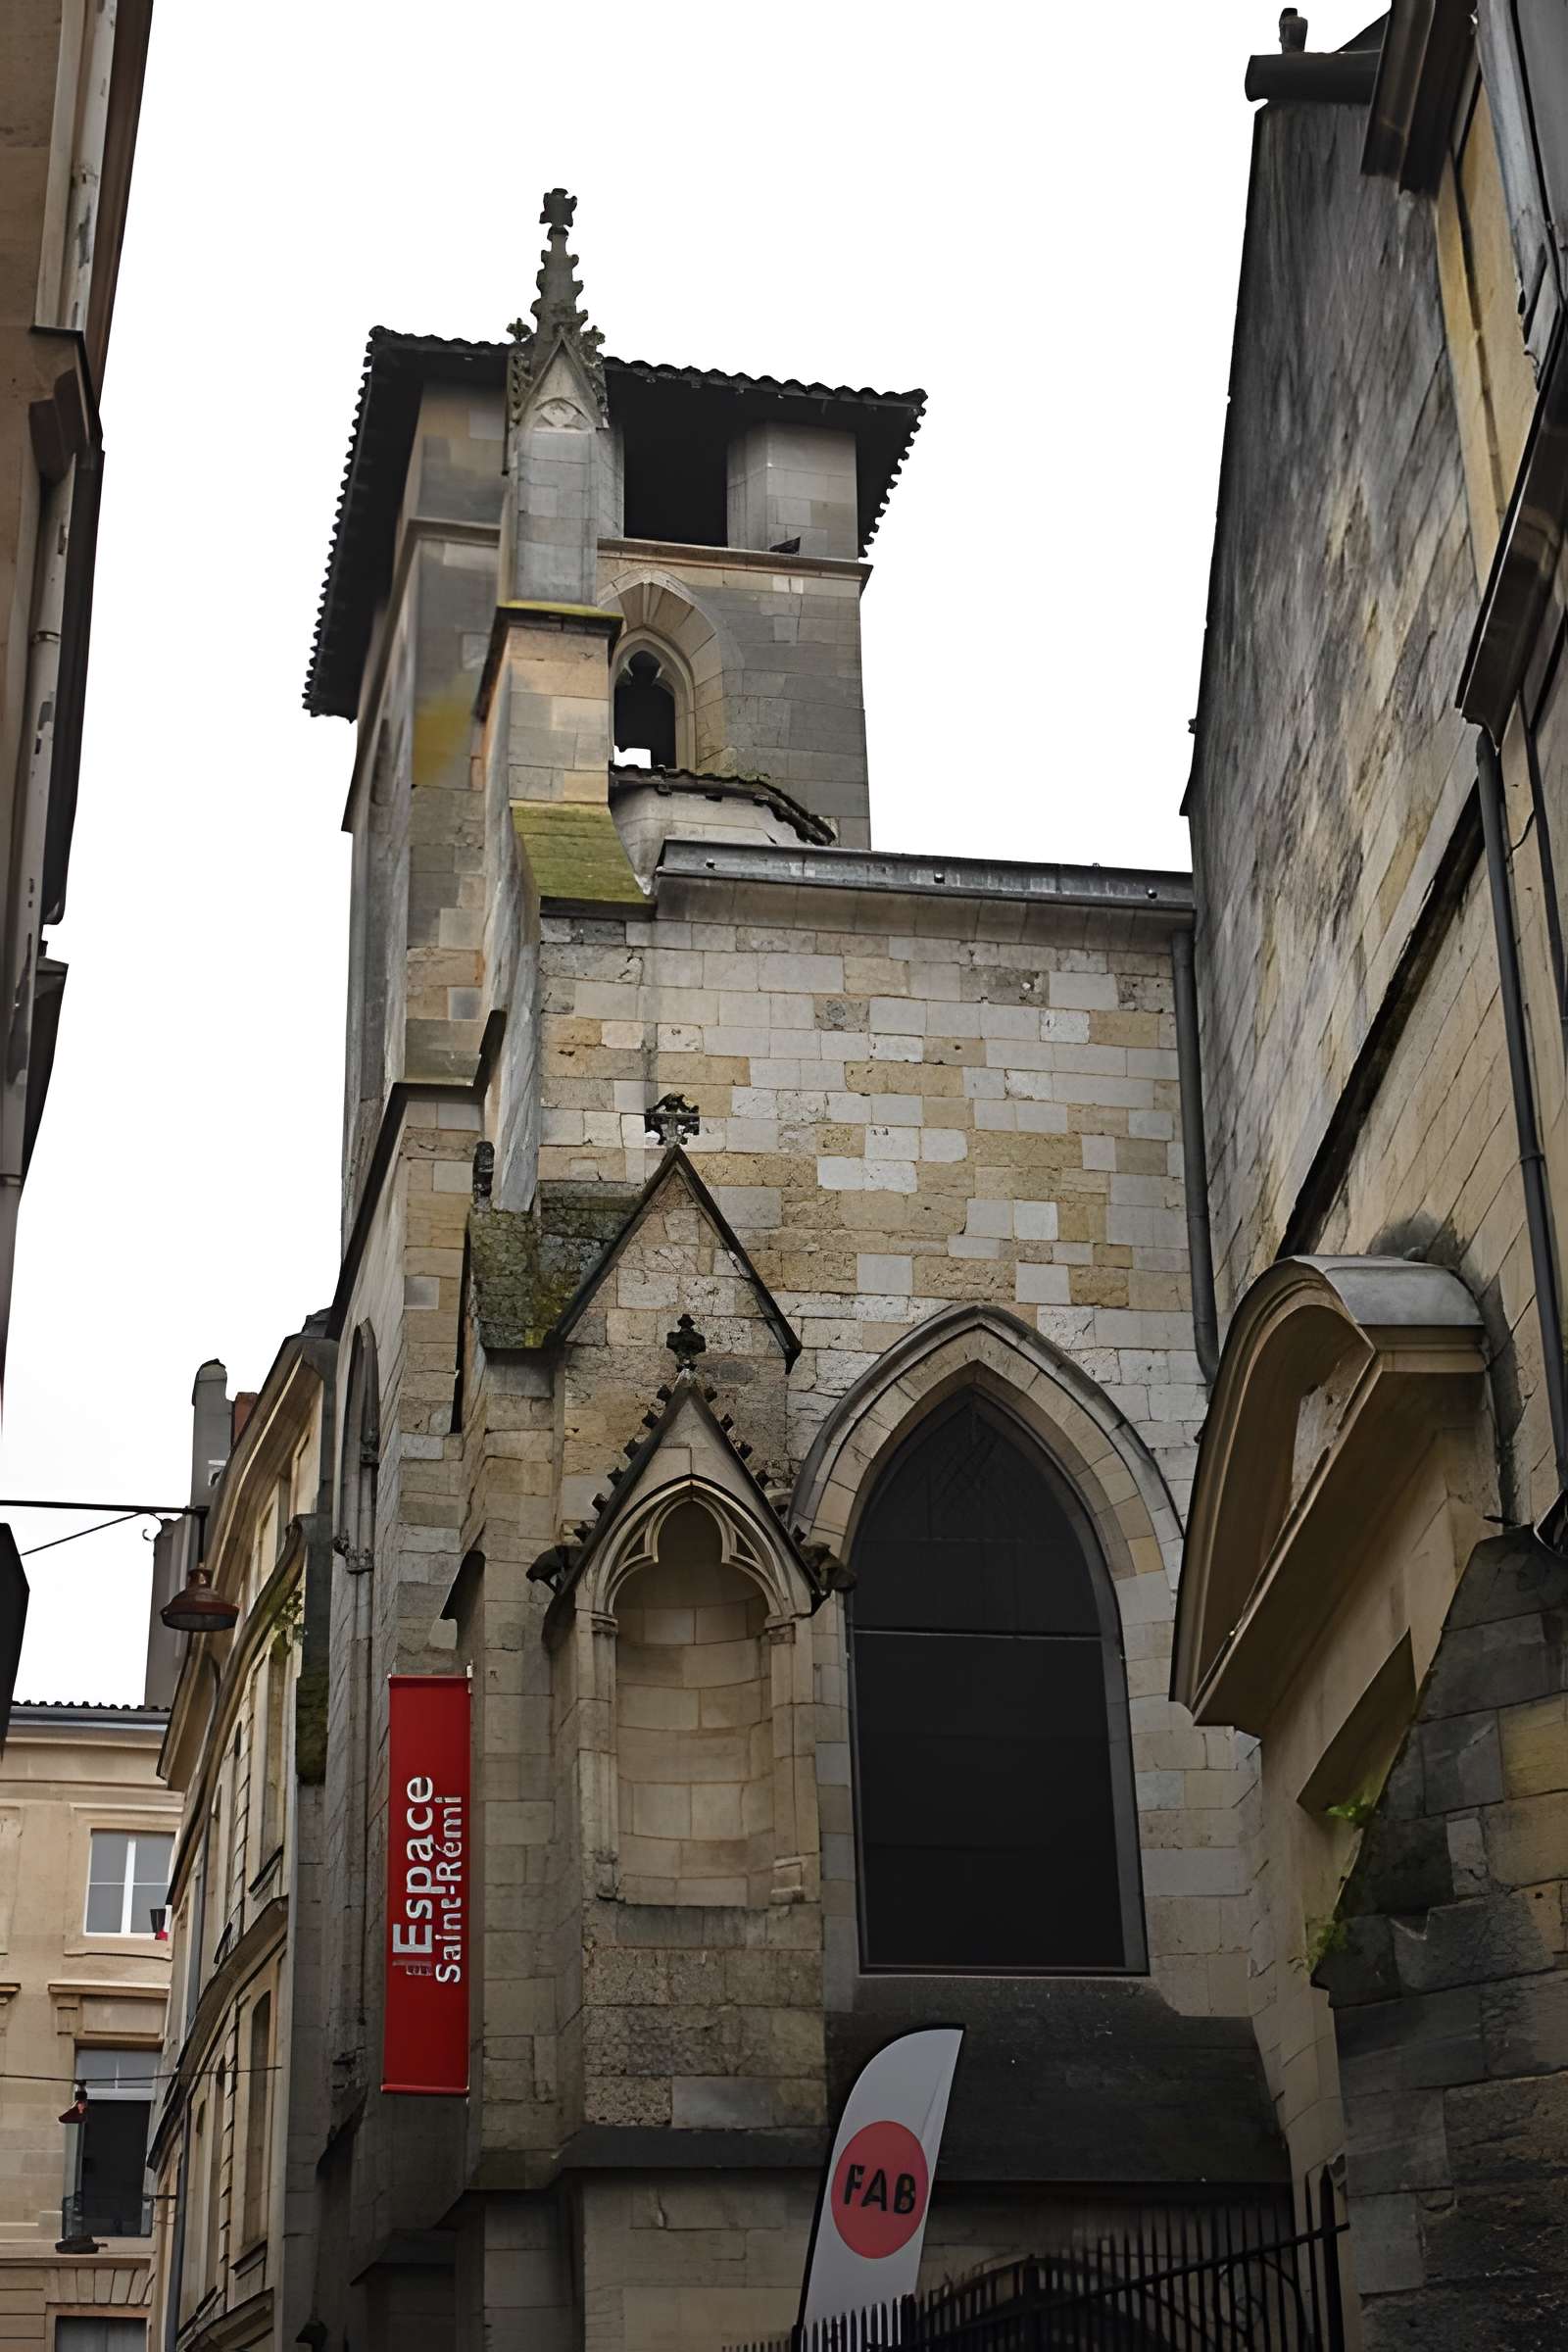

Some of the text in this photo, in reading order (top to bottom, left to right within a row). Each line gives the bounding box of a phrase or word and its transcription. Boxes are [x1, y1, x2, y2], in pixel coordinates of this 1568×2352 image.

[393, 1776, 446, 1953] Espace
[435, 1796, 463, 1984] Saint-Rémi
[844, 2164, 916, 2214] FAB
